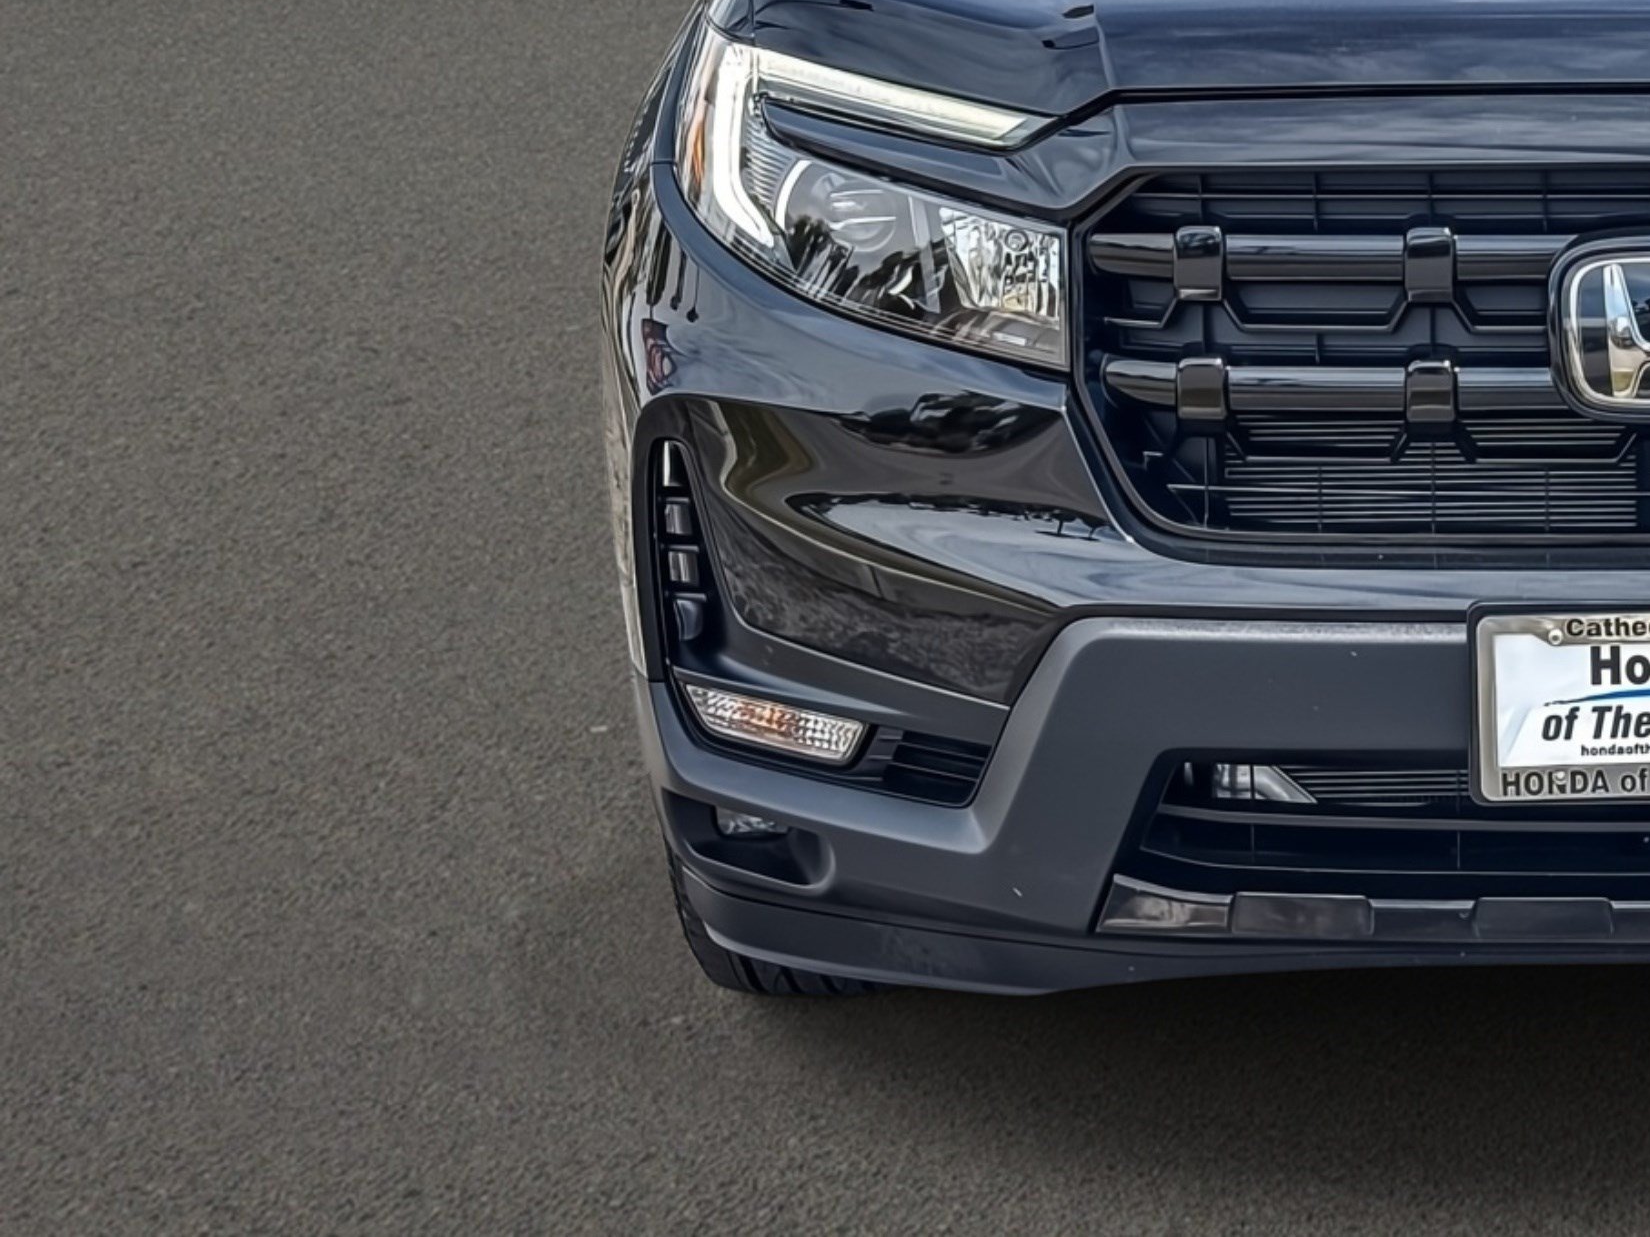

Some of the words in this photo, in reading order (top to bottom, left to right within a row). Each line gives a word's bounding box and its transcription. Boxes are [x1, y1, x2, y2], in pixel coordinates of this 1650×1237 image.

[1542, 706, 1579, 741] of
[1502, 769, 1611, 797] HONDA
[1620, 767, 1650, 792] of
